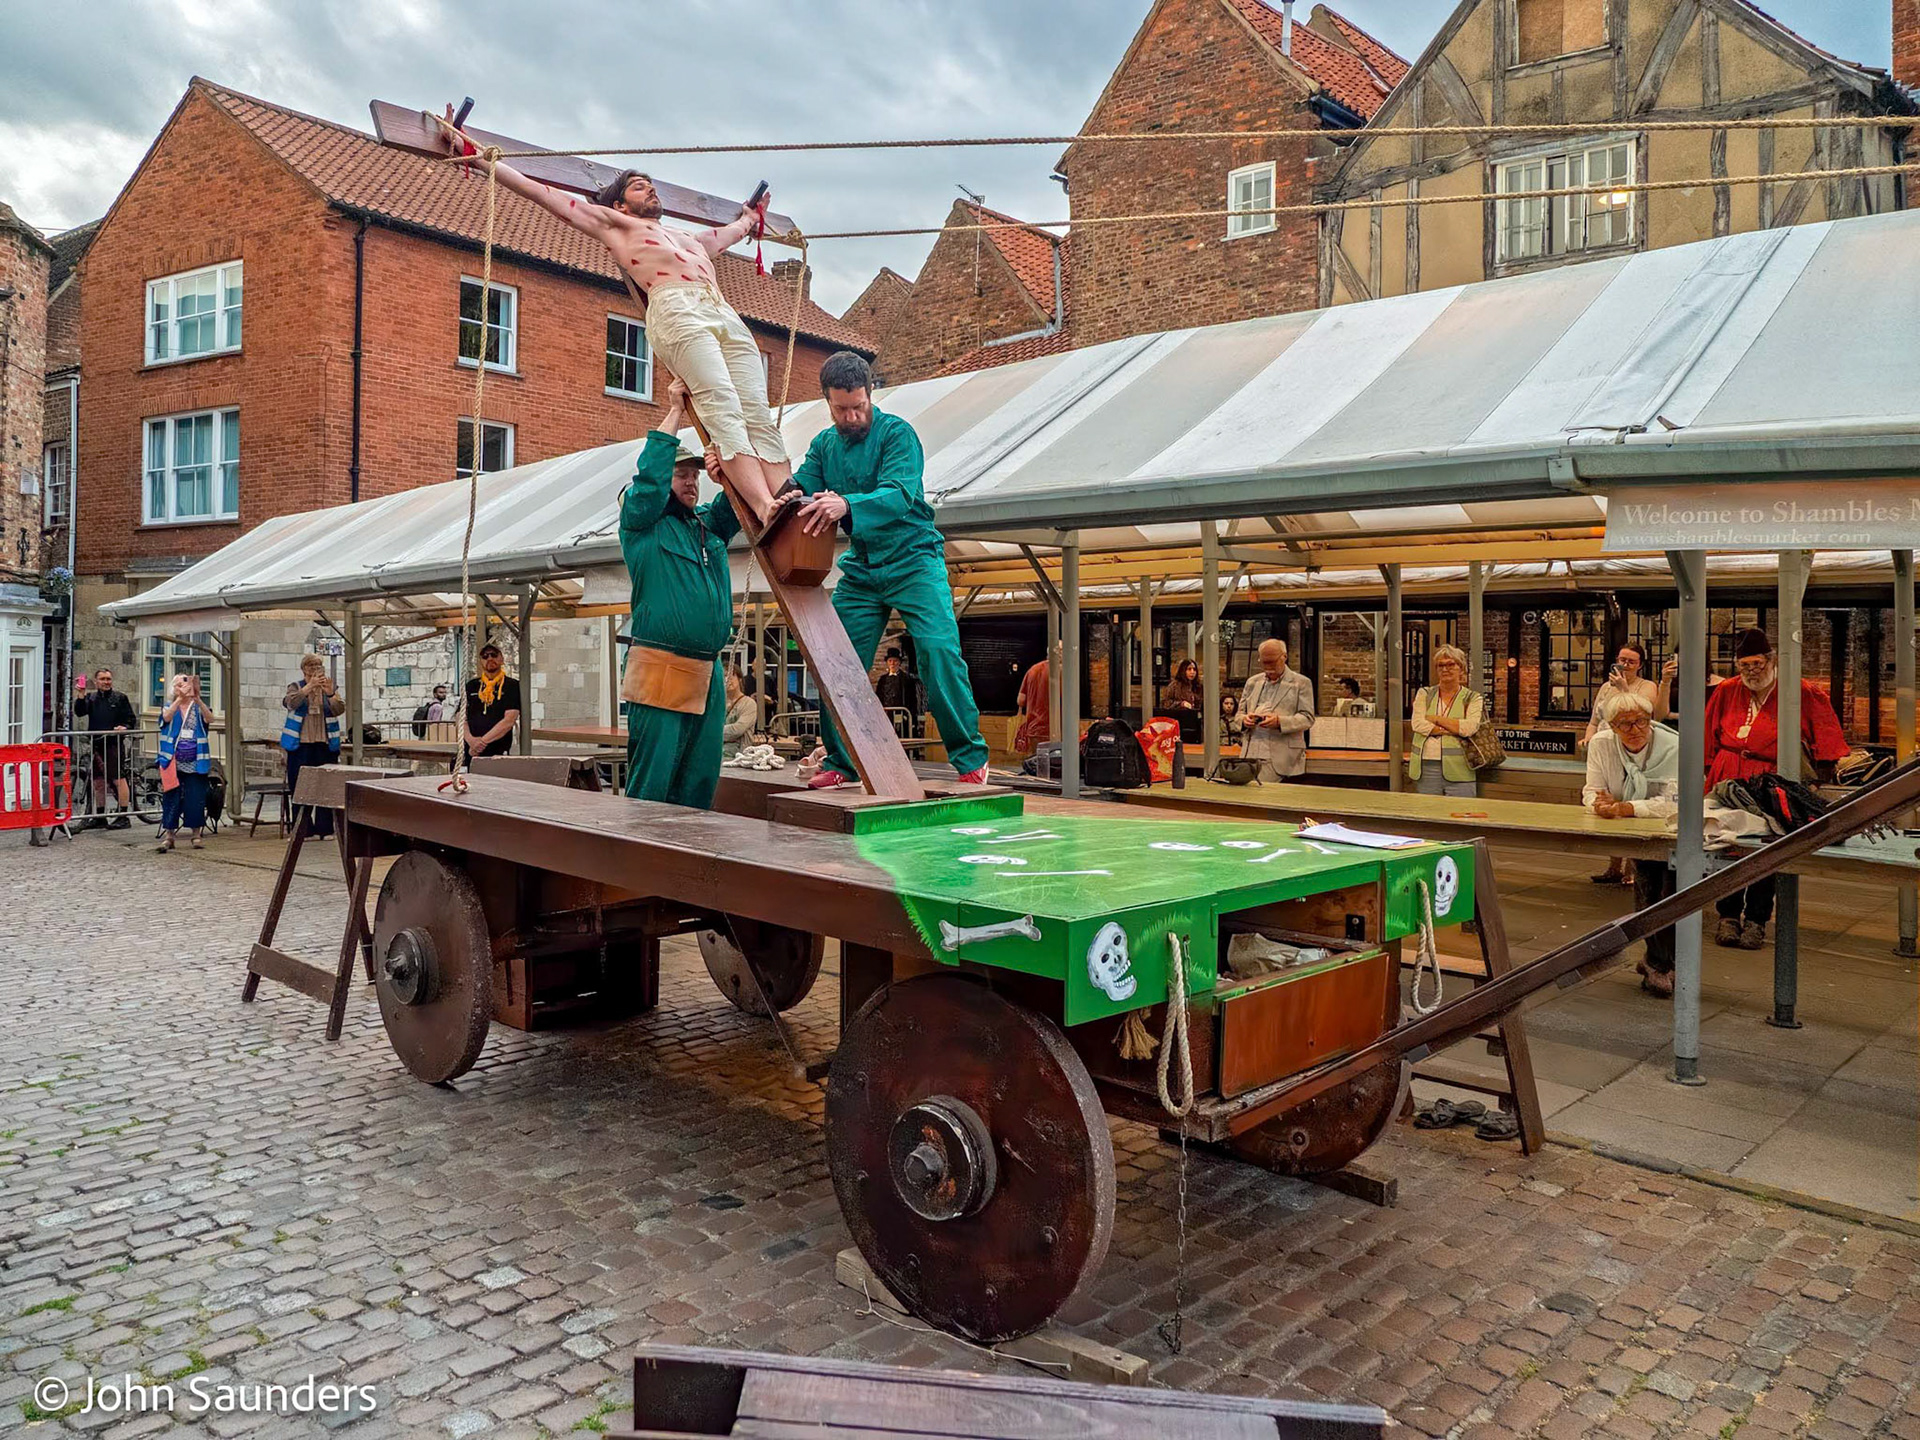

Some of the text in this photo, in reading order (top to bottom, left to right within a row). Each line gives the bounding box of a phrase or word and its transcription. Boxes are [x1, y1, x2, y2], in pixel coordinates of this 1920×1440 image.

[1622, 502, 1732, 525] Welcome
[1740, 504, 1764, 523] to
[1772, 499, 1900, 523] Shambles
[1619, 529, 1872, 546] www.shamblesmarket.com
[1501, 740, 1567, 751] RKET TAVERN
